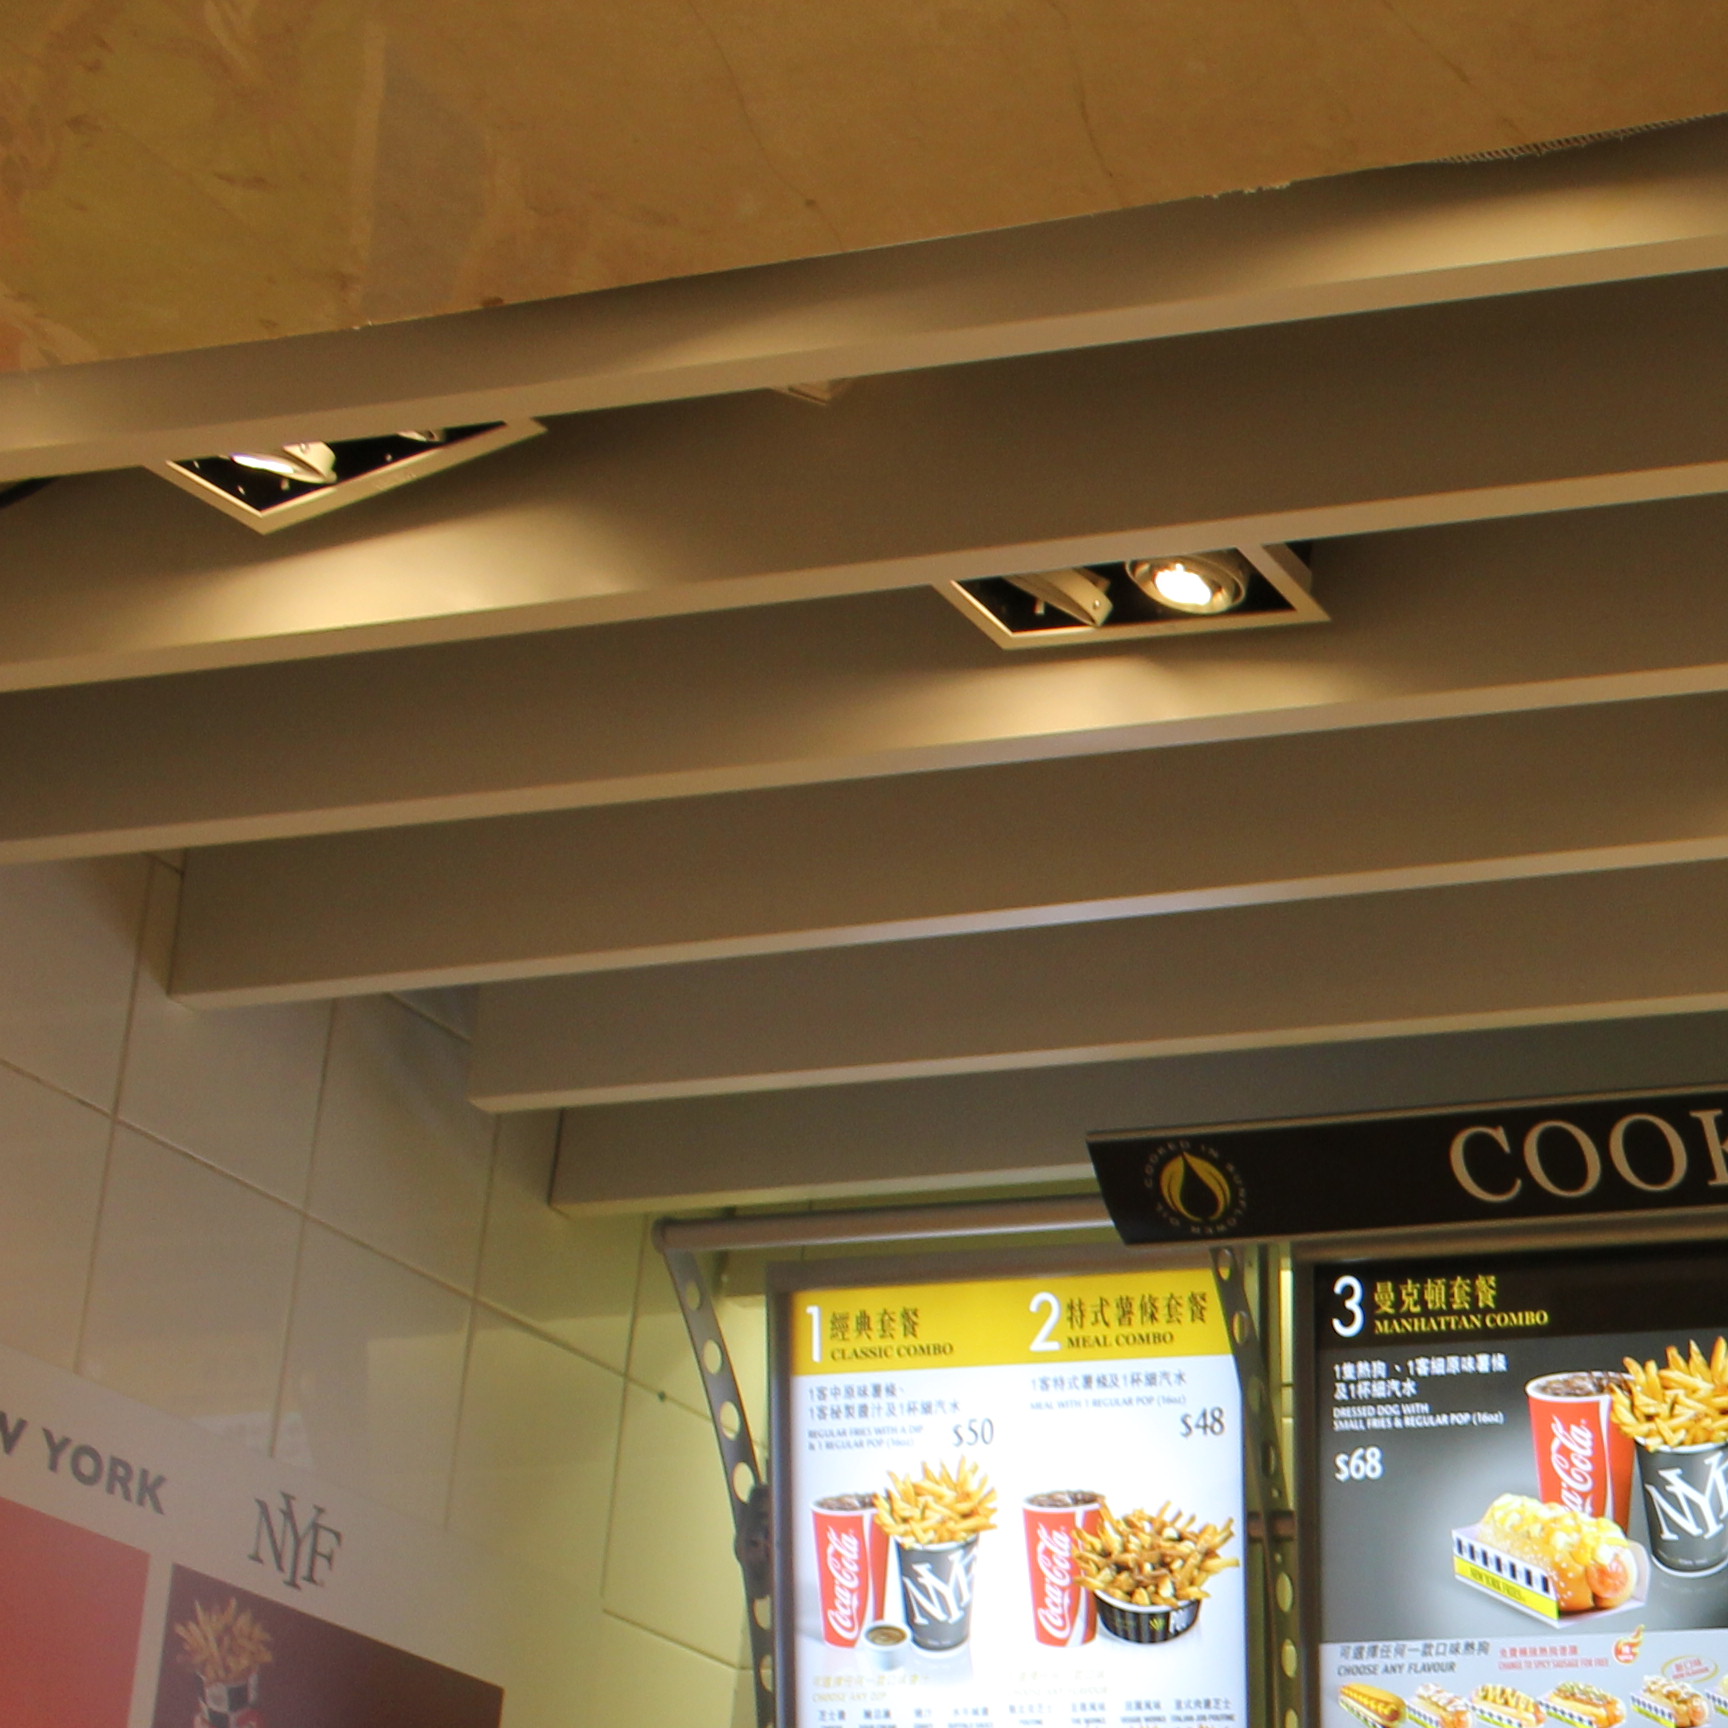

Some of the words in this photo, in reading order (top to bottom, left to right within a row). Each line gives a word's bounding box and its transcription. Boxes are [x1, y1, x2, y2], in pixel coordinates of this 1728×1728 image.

[1066, 1291, 1207, 1330] 特式薯條套餐
[1331, 1274, 1365, 1338] 3
[1374, 1273, 1497, 1315] 曼克頓套餐
[806, 1305, 822, 1363] 1
[829, 1306, 919, 1342] 經典套餐
[1029, 1292, 1061, 1352] 2
[1066, 1334, 1112, 1349] MEAL
[1115, 1332, 1174, 1347] COMBO
[1374, 1313, 1482, 1335] MANHATTAN
[1485, 1309, 1549, 1329] COMBO
[831, 1346, 894, 1361] CLASSIC
[896, 1343, 954, 1359] COMBO
[1180, 1406, 1225, 1437] $48
[1401, 1402, 1430, 1415] WITH
[952, 1417, 994, 1447] $50
[44, 1428, 167, 1515] YORK
[1334, 1446, 1383, 1482] $68
[249, 1491, 342, 1590] NYF
[827, 1526, 860, 1640] Coca-Cola
[1037, 1523, 1072, 1639] Coca-Cola
[1337, 1664, 1378, 1676] CHOOSE
[1382, 1663, 1404, 1675] ANY
[1407, 1661, 1456, 1674] FLAVOUR
